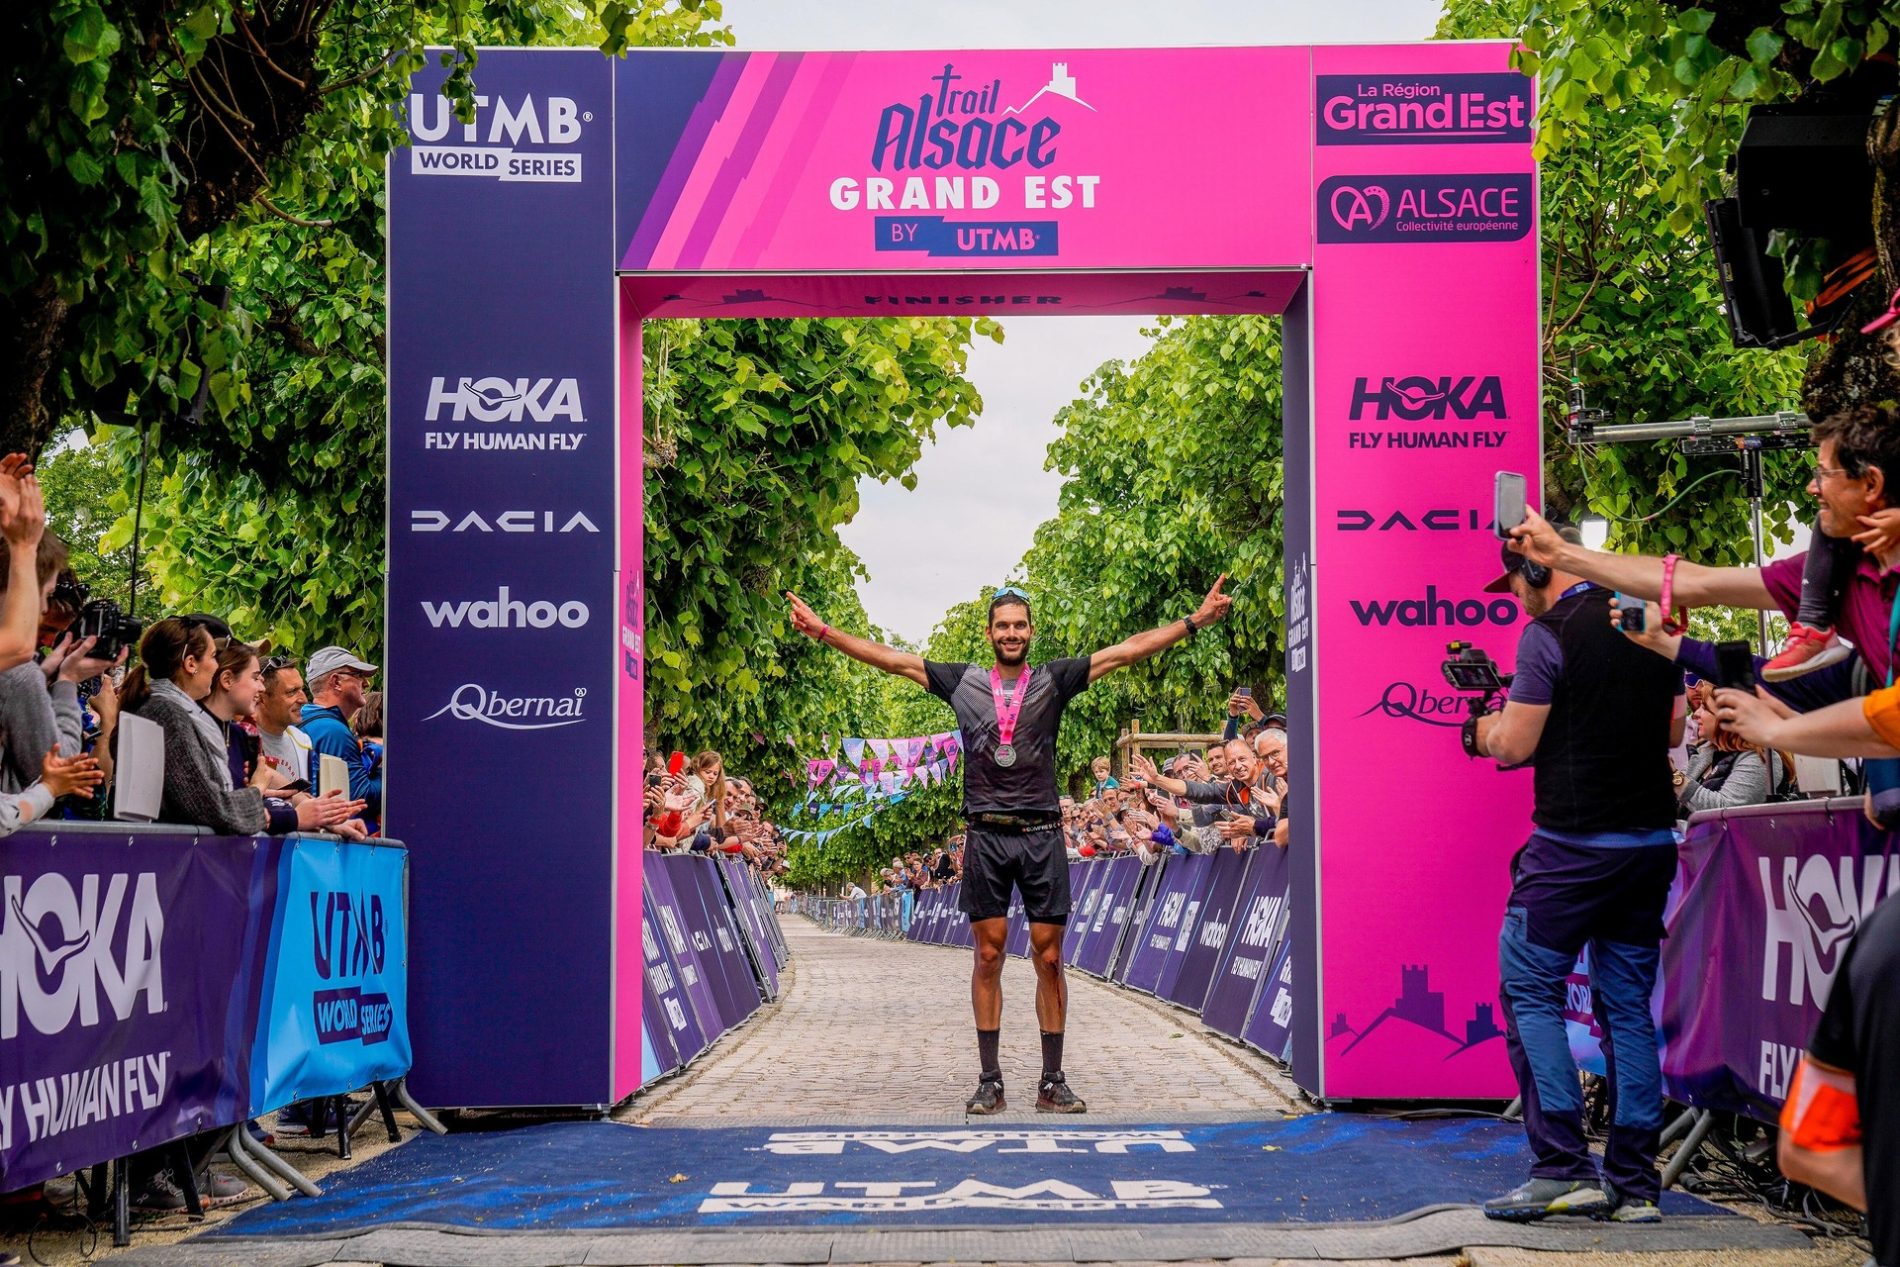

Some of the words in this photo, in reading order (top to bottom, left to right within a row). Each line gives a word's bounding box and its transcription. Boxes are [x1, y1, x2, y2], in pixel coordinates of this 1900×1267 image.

[931, 63, 1000, 118] trail
[1358, 83, 1378, 97] La
[1383, 82, 1440, 99] Région
[1323, 94, 1453, 130] Grand
[1460, 93, 1525, 129] Est
[872, 93, 1061, 172] Alsace
[419, 152, 499, 170] WORLD
[508, 159, 576, 176] SERIES
[829, 176, 1000, 211] GRAND
[1024, 175, 1101, 209] EST
[1396, 187, 1519, 218] ALSACE
[891, 223, 918, 242] BY
[1396, 220, 1454, 232] Collectivité
[1456, 220, 1518, 233] européenne
[957, 227, 1036, 251] UTMB
[864, 295, 1062, 306] FINISHER
[424, 376, 584, 423] HOKA
[1348, 376, 1508, 422] HOKA
[425, 432, 460, 450] FLY
[463, 433, 545, 450] HUMAN
[549, 433, 584, 450] FLY
[1349, 432, 1383, 449] FLY
[1387, 432, 1469, 448] HUMAN
[1473, 431, 1508, 447] FLY
[411, 510, 600, 533] DACIA
[1337, 510, 1494, 531] DACI
[420, 586, 590, 629] wahoo
[1349, 585, 1519, 627] wahoo
[19, 1061, 121, 1143] HUMAN
[123, 1051, 168, 1115] FLY
[709, 1179, 1213, 1200] UTMB
